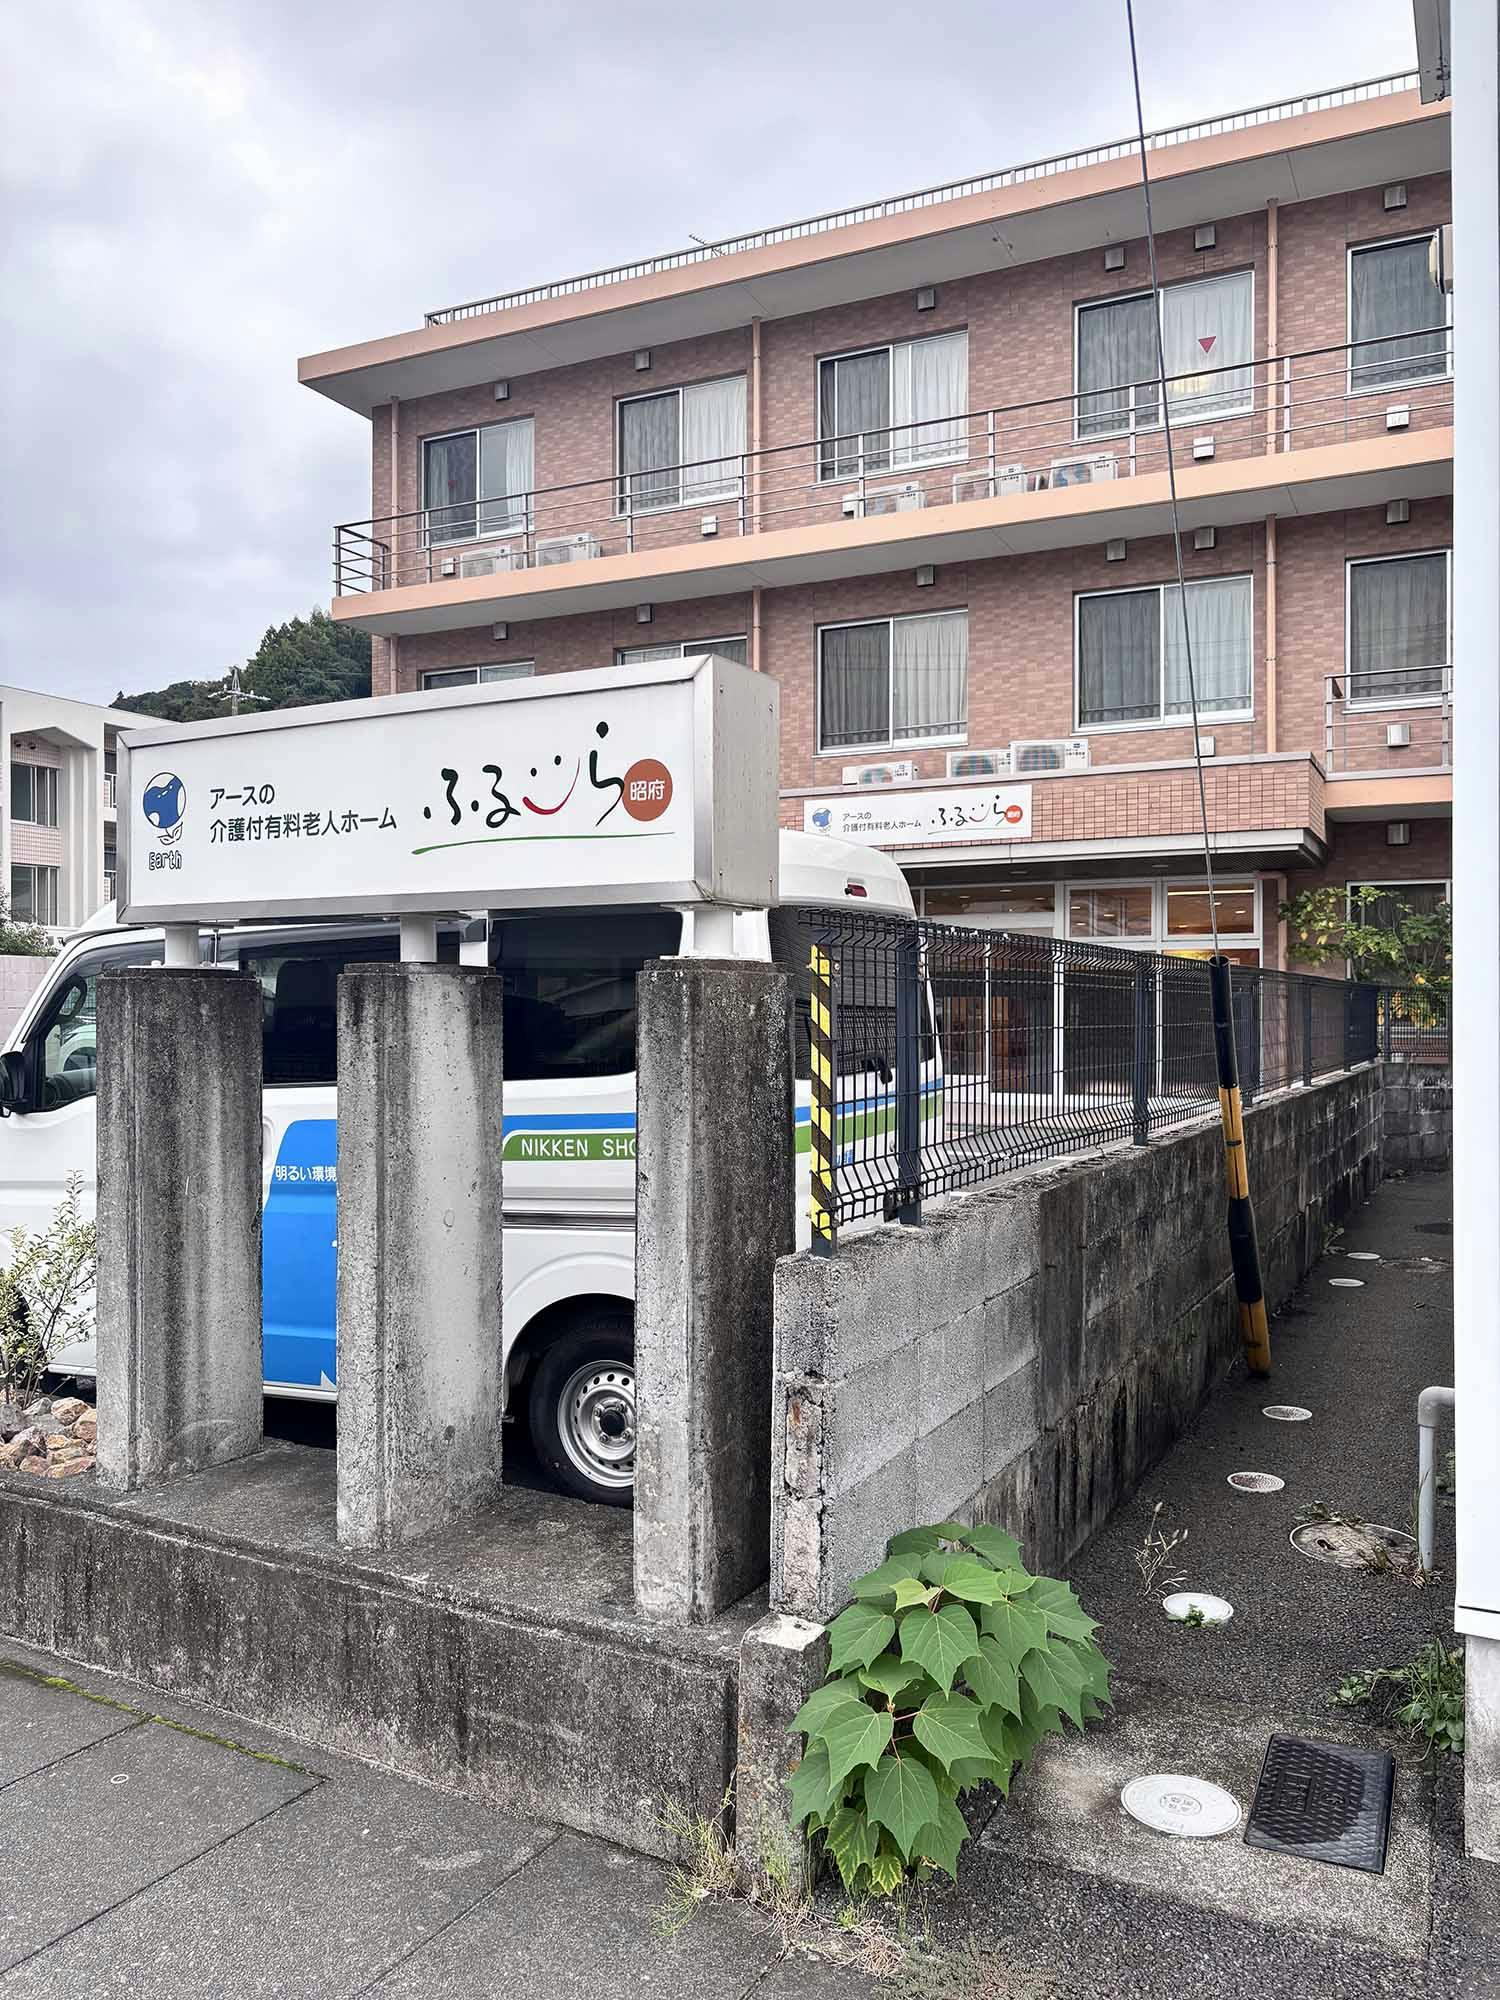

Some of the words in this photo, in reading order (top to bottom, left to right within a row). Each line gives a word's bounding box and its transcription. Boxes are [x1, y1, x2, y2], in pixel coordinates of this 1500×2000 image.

[210, 783, 275, 809] アースの
[630, 779, 665, 802] 昭府
[210, 807, 397, 844] 介護付有料老人ホーム
[842, 811, 872, 821] アースの
[842, 819, 921, 832] 介護付有料老人ホーム
[149, 850, 182, 870] Earth
[521, 1138, 588, 1157] NIKKEN
[275, 1165, 337, 1182] 明るい環境
